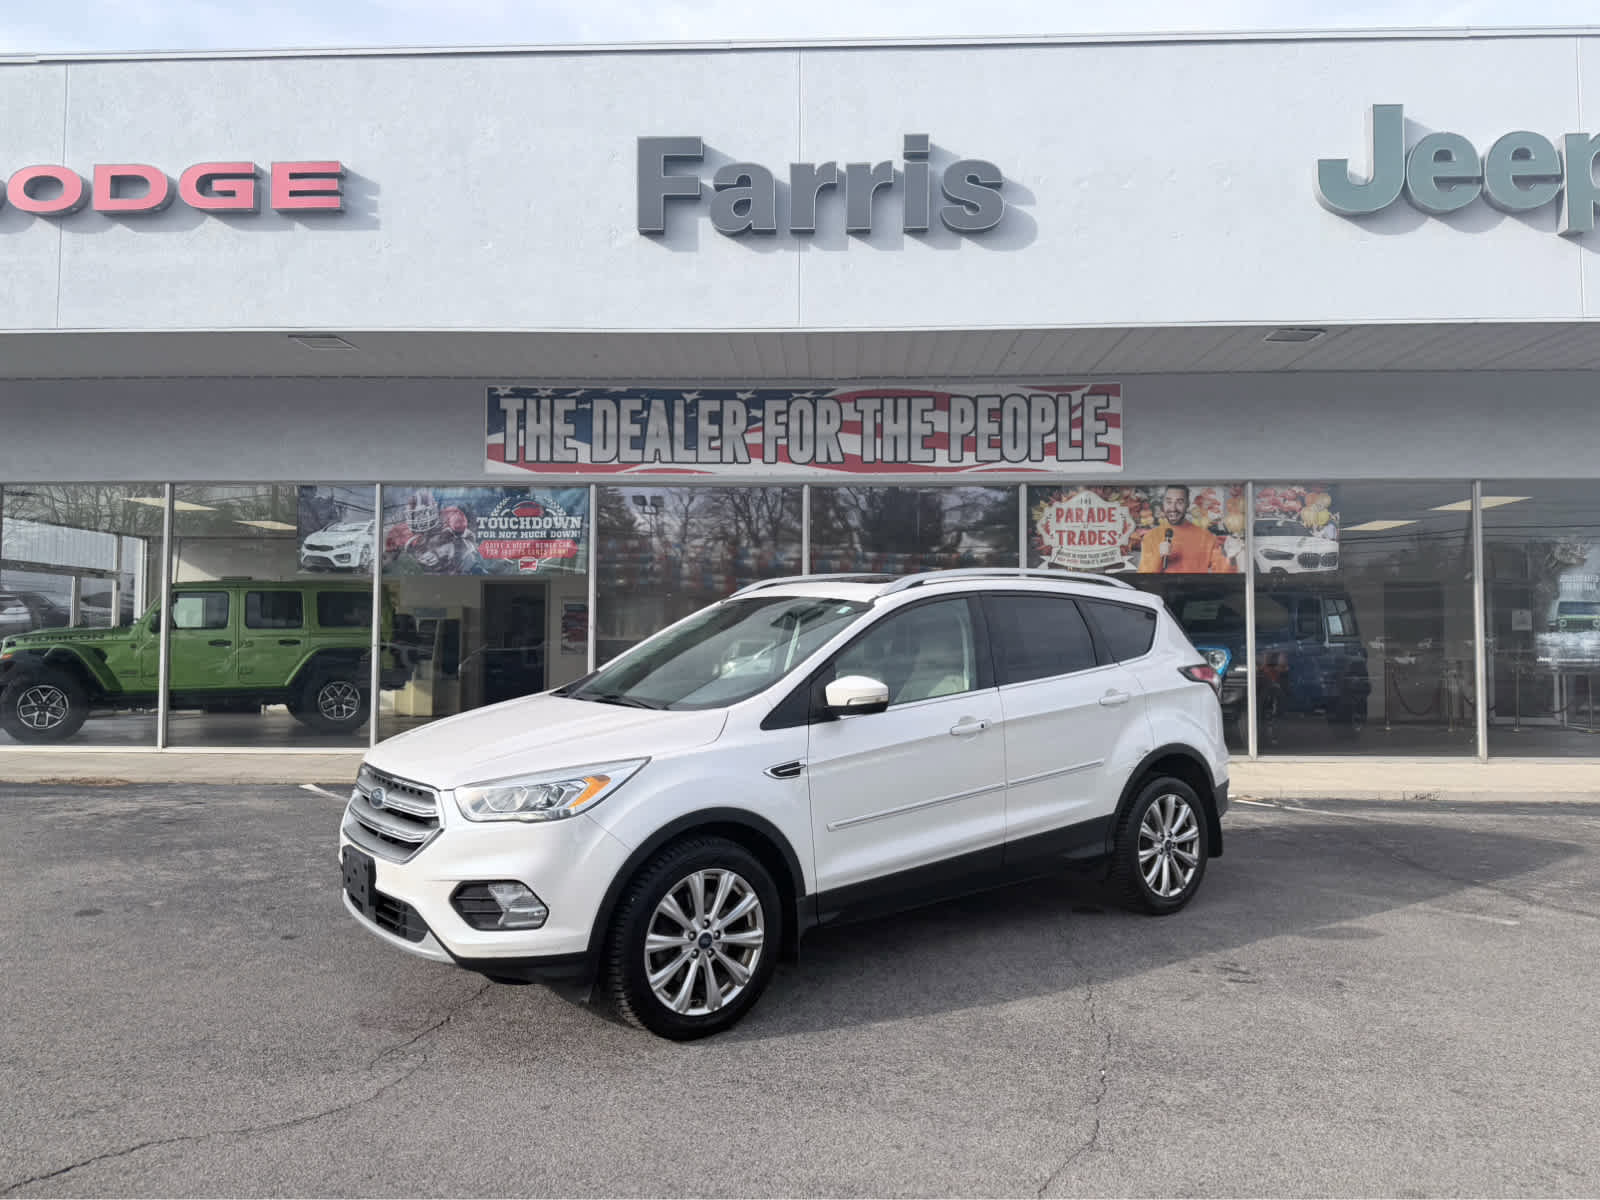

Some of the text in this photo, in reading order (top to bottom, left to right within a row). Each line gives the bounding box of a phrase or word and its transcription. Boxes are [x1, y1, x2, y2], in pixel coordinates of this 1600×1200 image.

[0, 161, 343, 213] ODGE
[636, 133, 1006, 237] Farris
[499, 393, 1110, 464] THE DEALER FOR THE PEOPLE
[476, 516, 582, 529] TOUCHDOWN
[1055, 507, 1117, 523] PARADE
[498, 531, 518, 539] NOT
[520, 531, 547, 539] MUCH
[1055, 530, 1118, 546] TRADES
